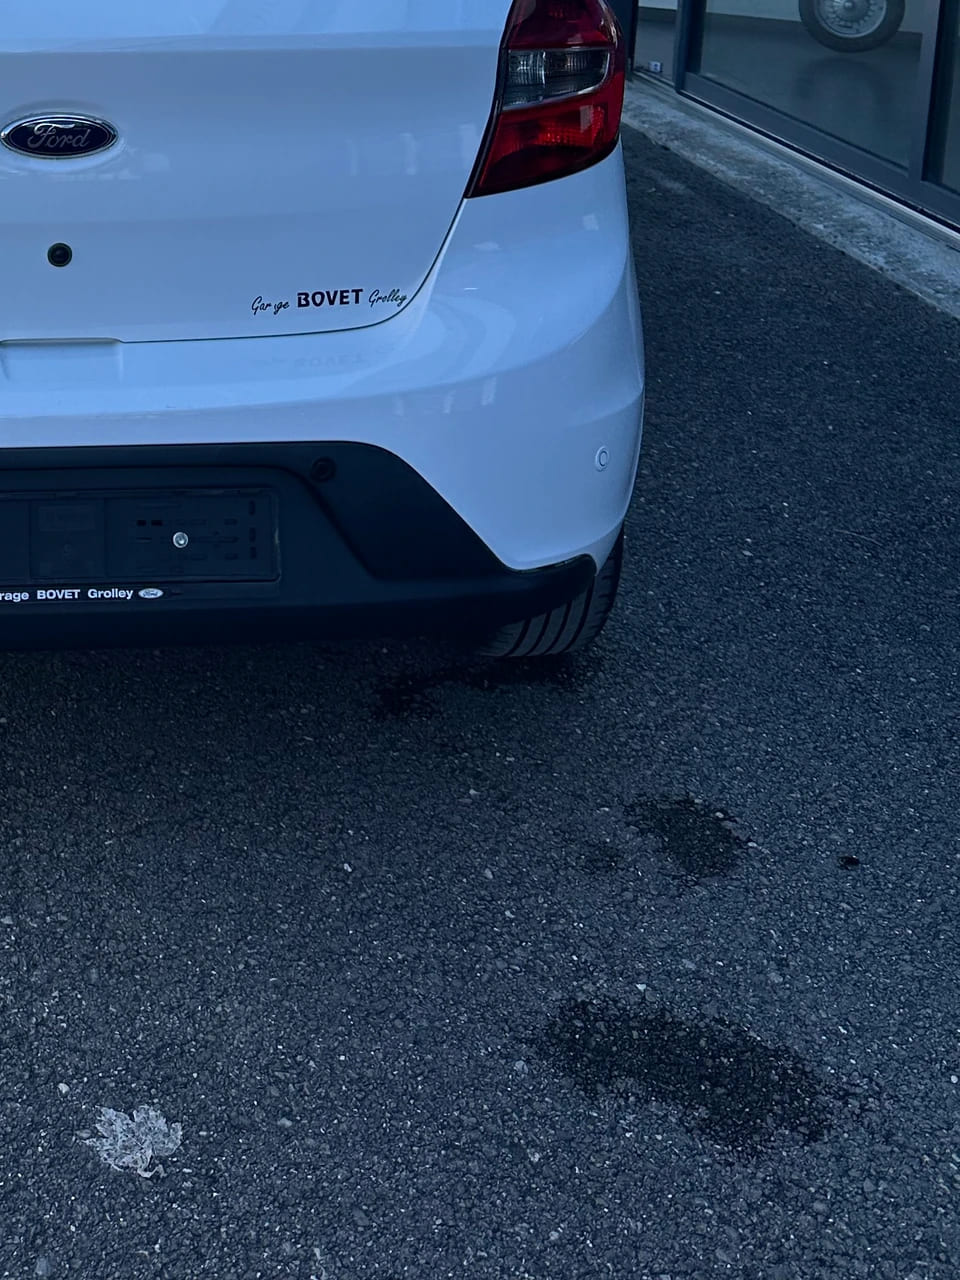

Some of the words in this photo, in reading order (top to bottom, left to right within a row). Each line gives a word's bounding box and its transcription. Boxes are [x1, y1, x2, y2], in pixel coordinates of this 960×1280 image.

[25, 122, 92, 149] Ford
[297, 288, 363, 308] BOVET
[368, 288, 407, 307] Grolley
[37, 589, 81, 600] BOVET
[87, 588, 134, 600] Grolley
